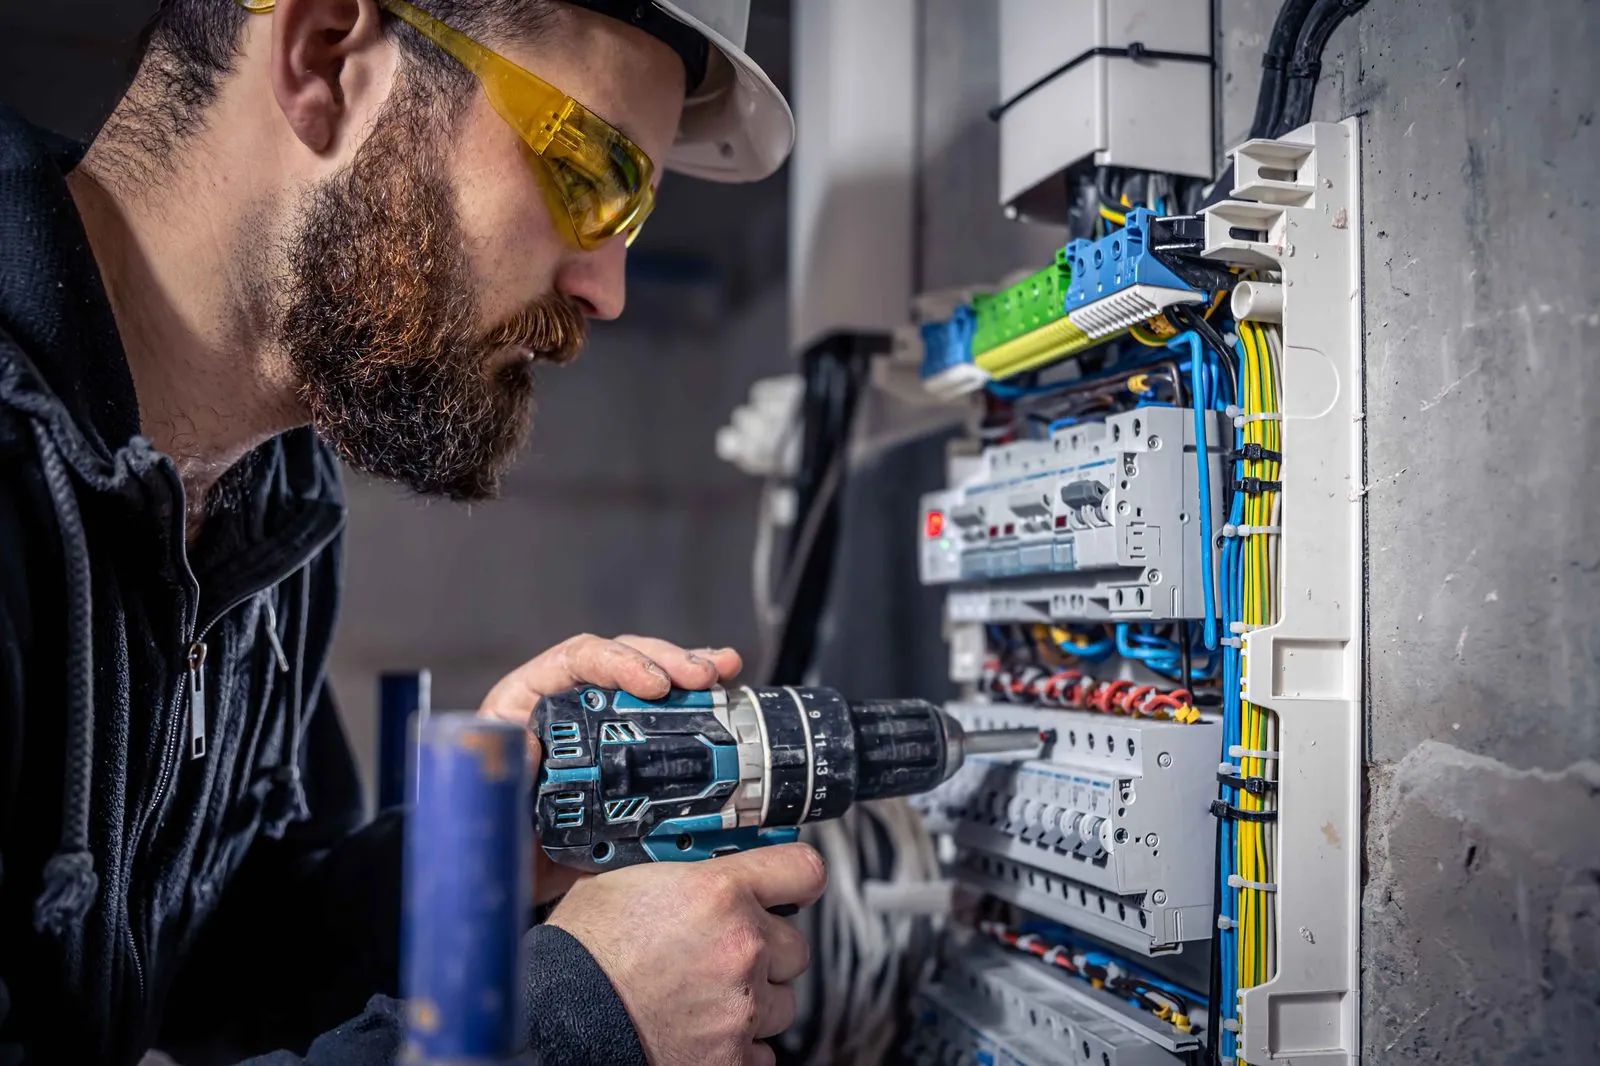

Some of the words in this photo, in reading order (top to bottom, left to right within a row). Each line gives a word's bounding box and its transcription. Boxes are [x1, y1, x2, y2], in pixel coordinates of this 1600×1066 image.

[808, 710, 822, 719] 9
[814, 732, 827, 748] 11
[816, 759, 829, 776] 13
[814, 786, 827, 800] 15
